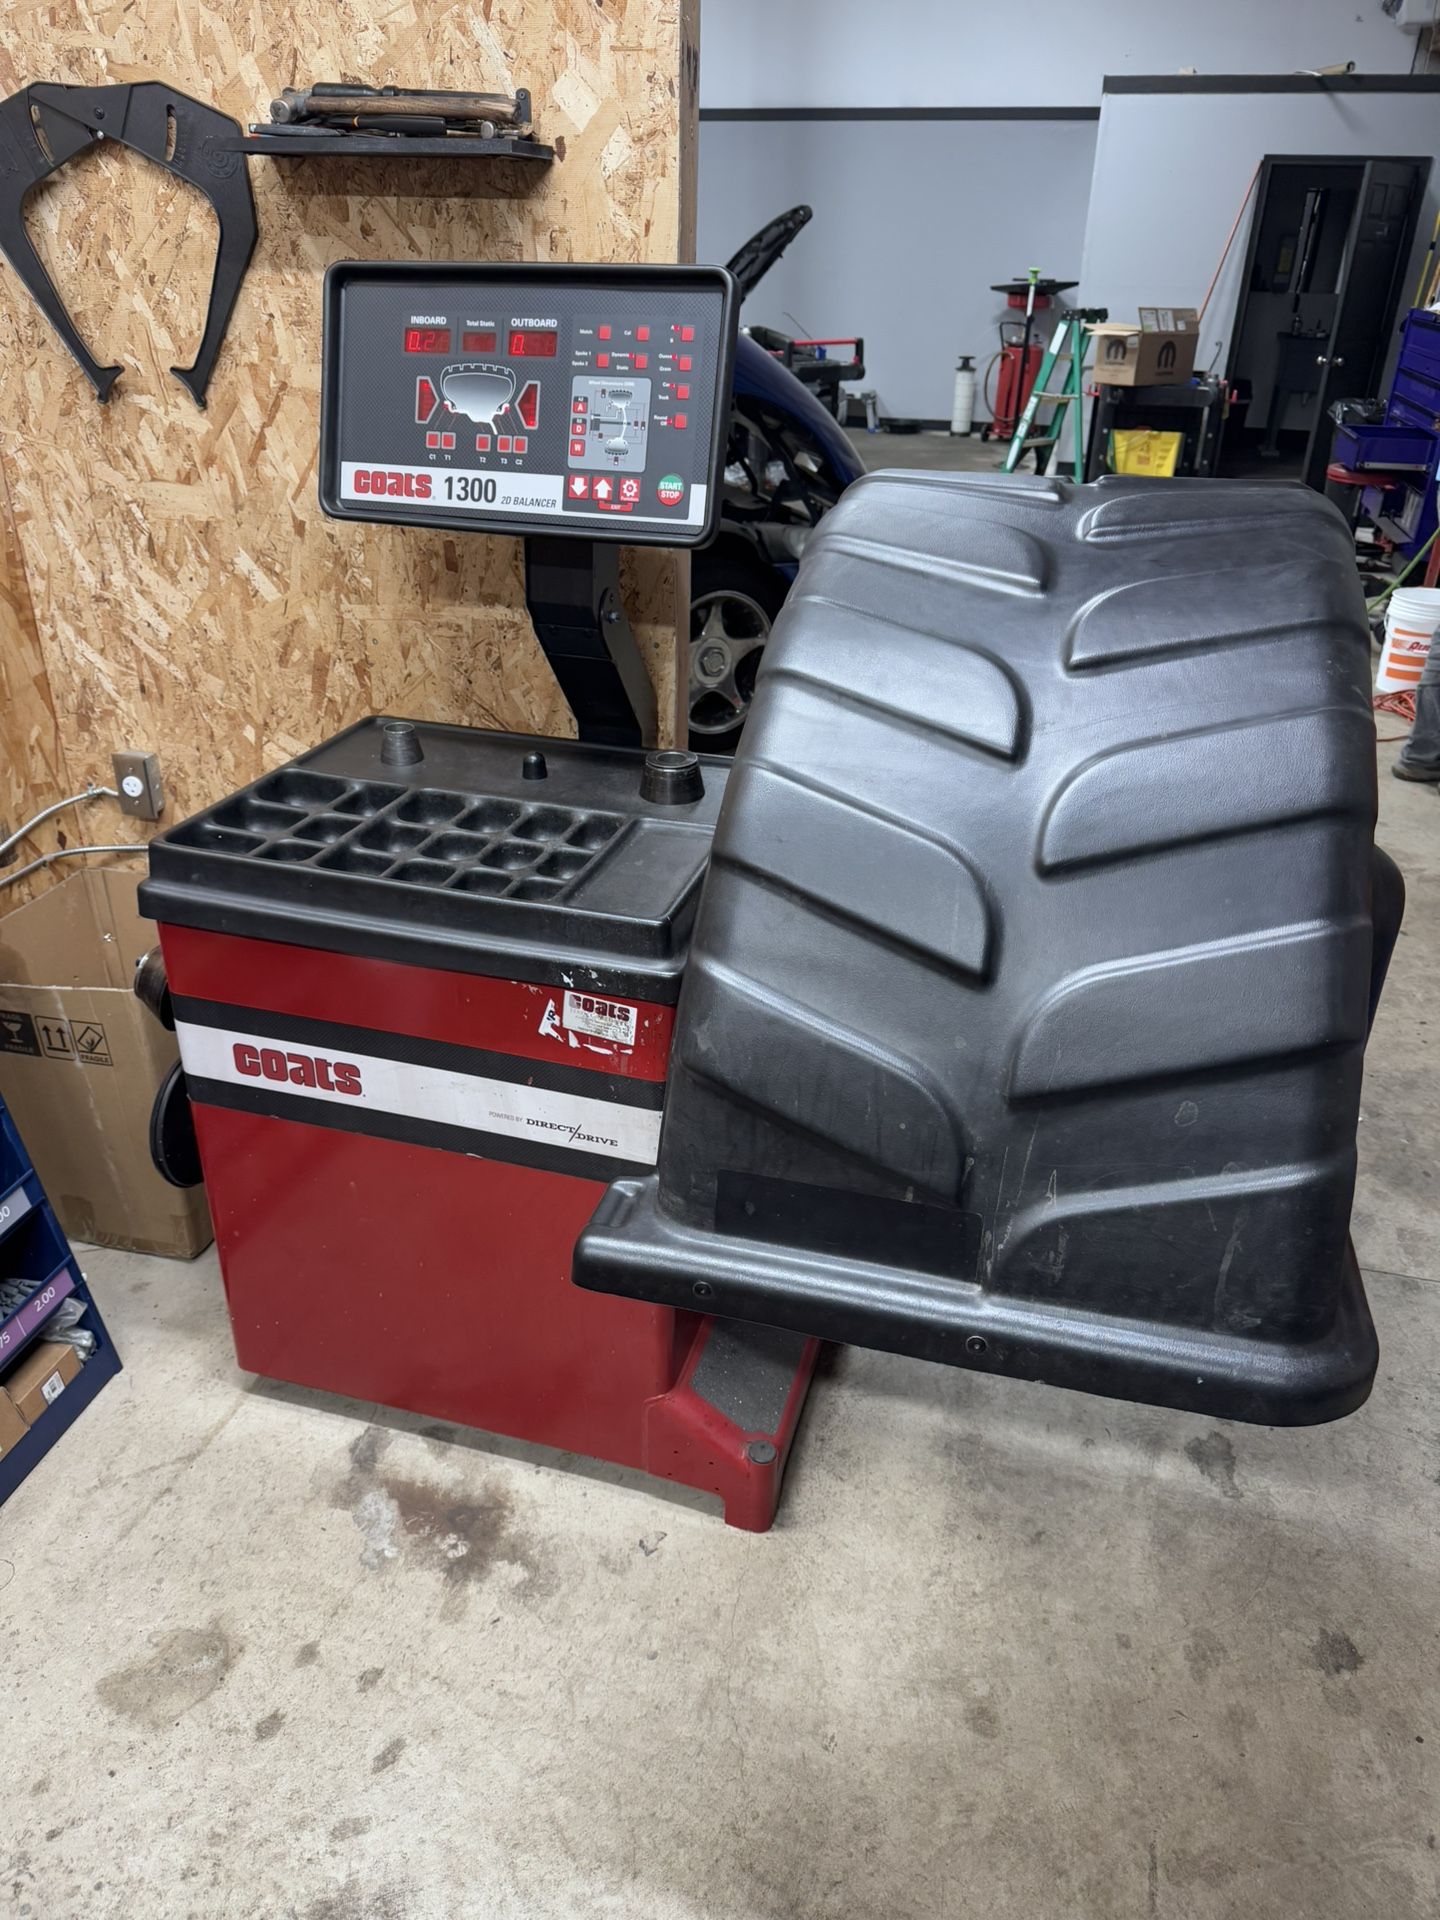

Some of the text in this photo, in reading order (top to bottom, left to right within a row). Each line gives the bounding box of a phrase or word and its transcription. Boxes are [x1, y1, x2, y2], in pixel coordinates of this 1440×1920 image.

[410, 315, 447, 325] INBOARD
[466, 319, 496, 328] Total Static
[511, 318, 558, 328] OUTBOARD
[577, 402, 584, 411] A
[576, 424, 582, 433] D
[574, 443, 582, 452] W
[660, 481, 682, 491] START
[444, 476, 497, 504] 1300
[500, 496, 512, 505] 2D
[513, 497, 557, 508] BALANCER
[660, 490, 680, 499] STOP
[80, 1053, 110, 1064] FRAGILE
[488, 1110, 515, 1121] POWERED
[34, 1286, 56, 1312] 2.00
